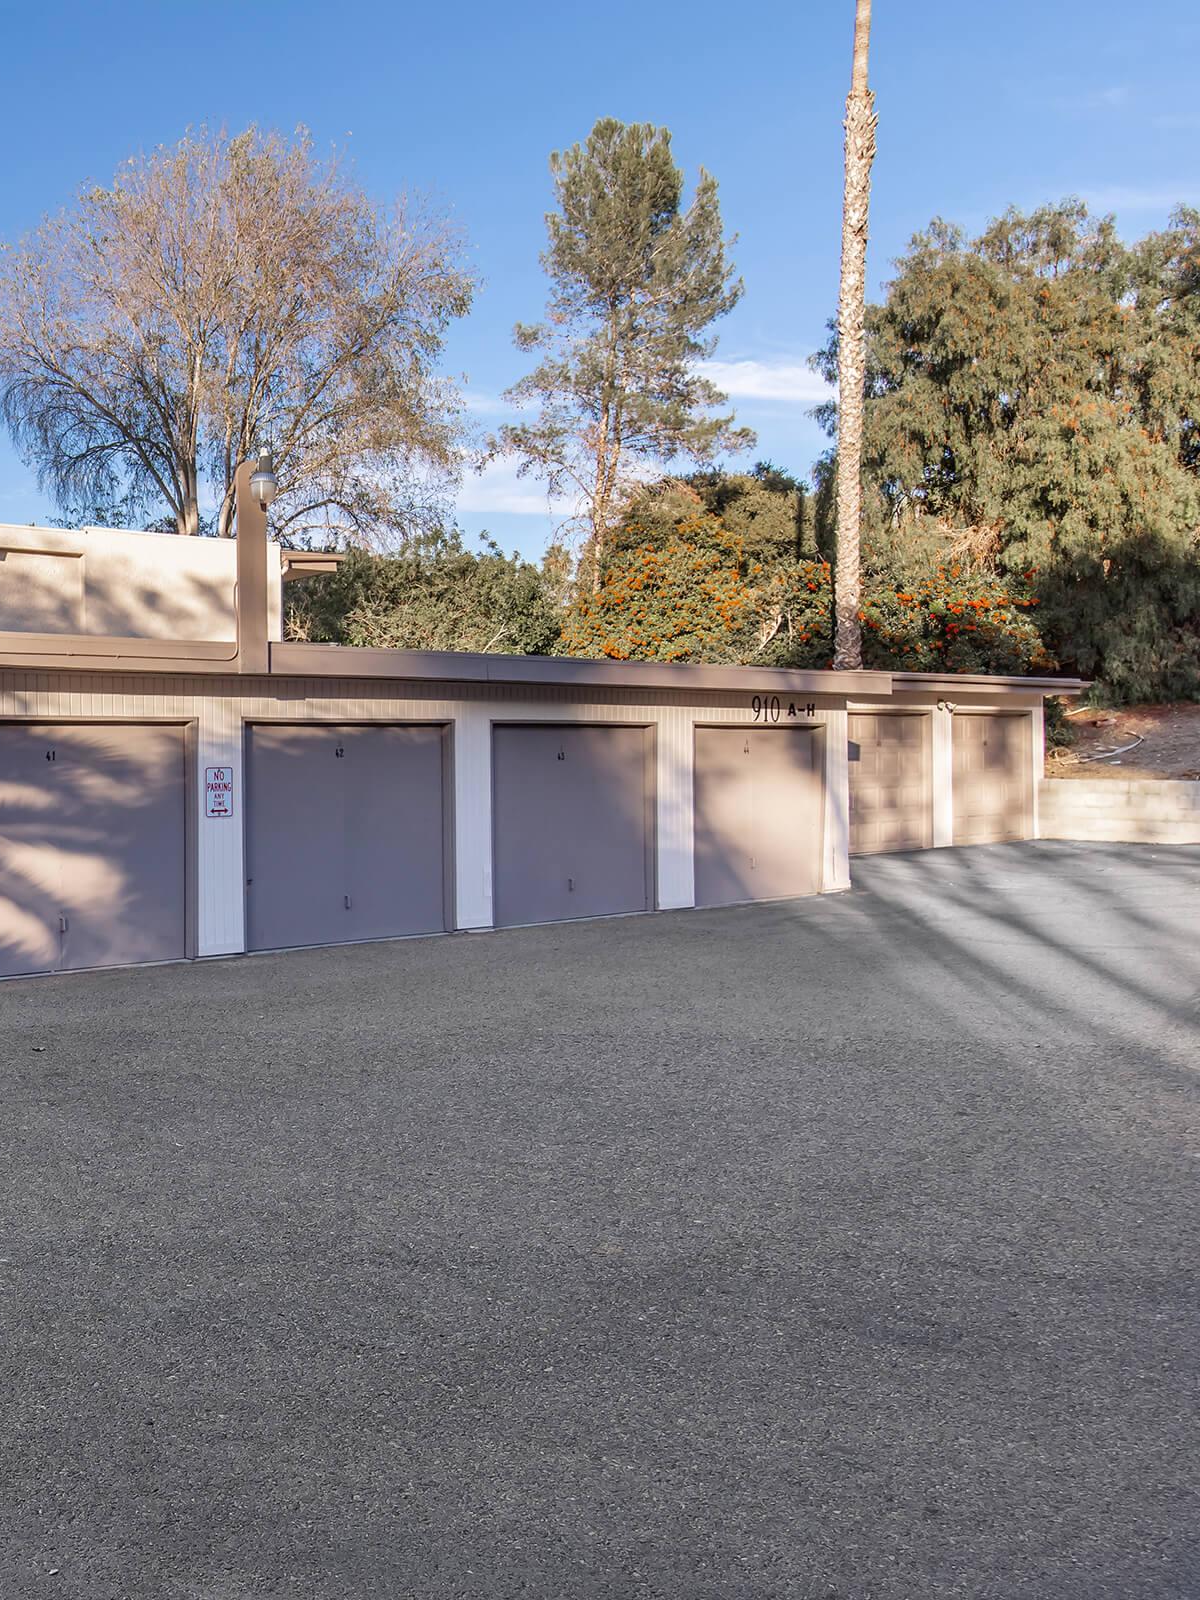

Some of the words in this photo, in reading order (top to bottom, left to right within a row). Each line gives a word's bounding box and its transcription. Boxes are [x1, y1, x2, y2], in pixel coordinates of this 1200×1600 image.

[751, 695, 780, 722] 910
[787, 702, 816, 717] A-H
[45, 751, 56, 761] 41
[213, 770, 224, 781] NO
[207, 782, 231, 792] PARKING
